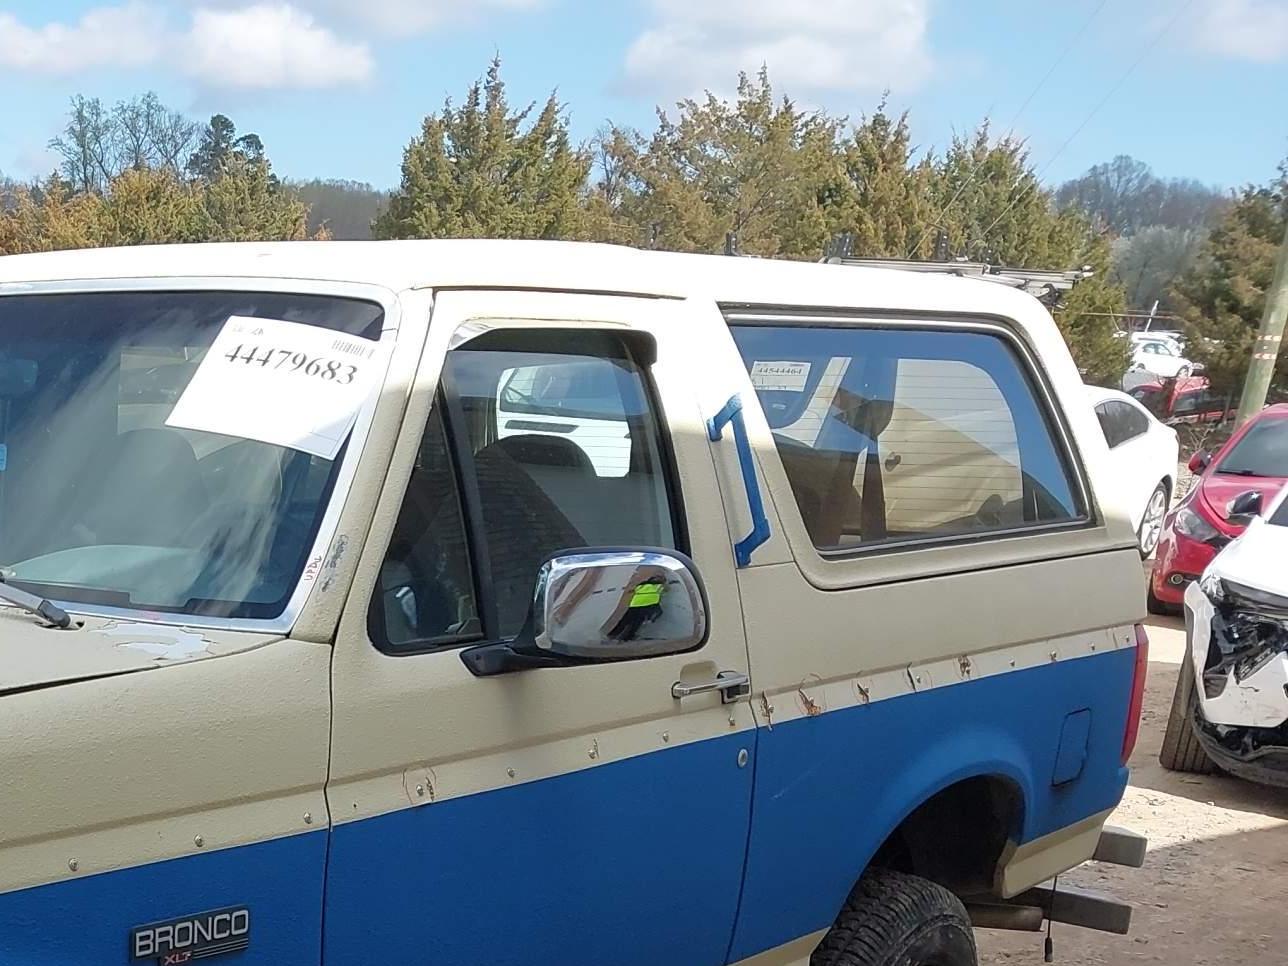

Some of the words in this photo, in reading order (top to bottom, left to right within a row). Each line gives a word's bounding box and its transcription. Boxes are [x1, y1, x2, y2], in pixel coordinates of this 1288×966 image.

[224, 344, 358, 384] 44479683
[135, 909, 249, 957] BRONCO
[164, 950, 192, 966] XLT
